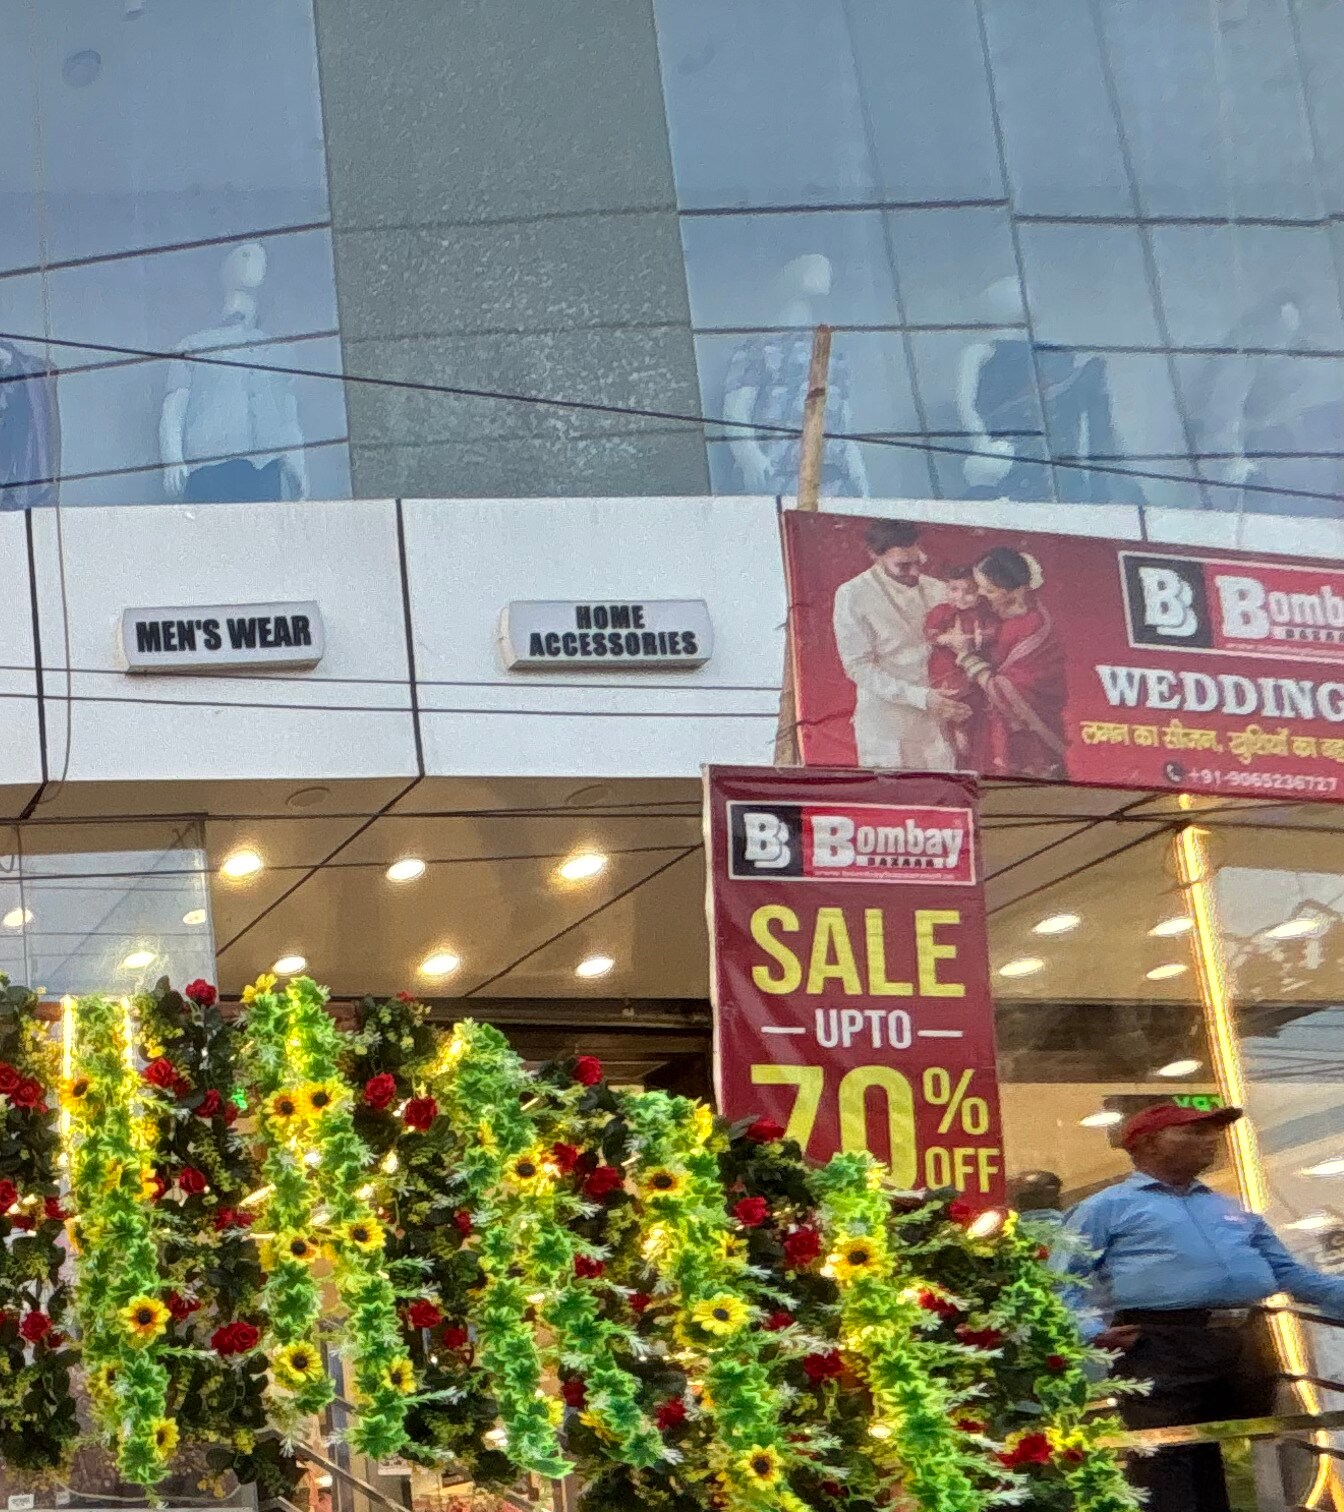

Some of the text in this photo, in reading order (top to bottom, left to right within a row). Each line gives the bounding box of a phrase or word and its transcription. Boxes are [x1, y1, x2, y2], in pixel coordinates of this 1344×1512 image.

[575, 605, 646, 630] HOME
[1215, 575, 1344, 640] Bomb
[135, 615, 312, 653] MEN'S WEAR
[529, 631, 698, 657] ACCESSORIES
[813, 815, 964, 869] Bombay
[750, 904, 965, 998] SALE
[815, 1009, 912, 1049] UPTO
[924, 1146, 1001, 1193] OFF
